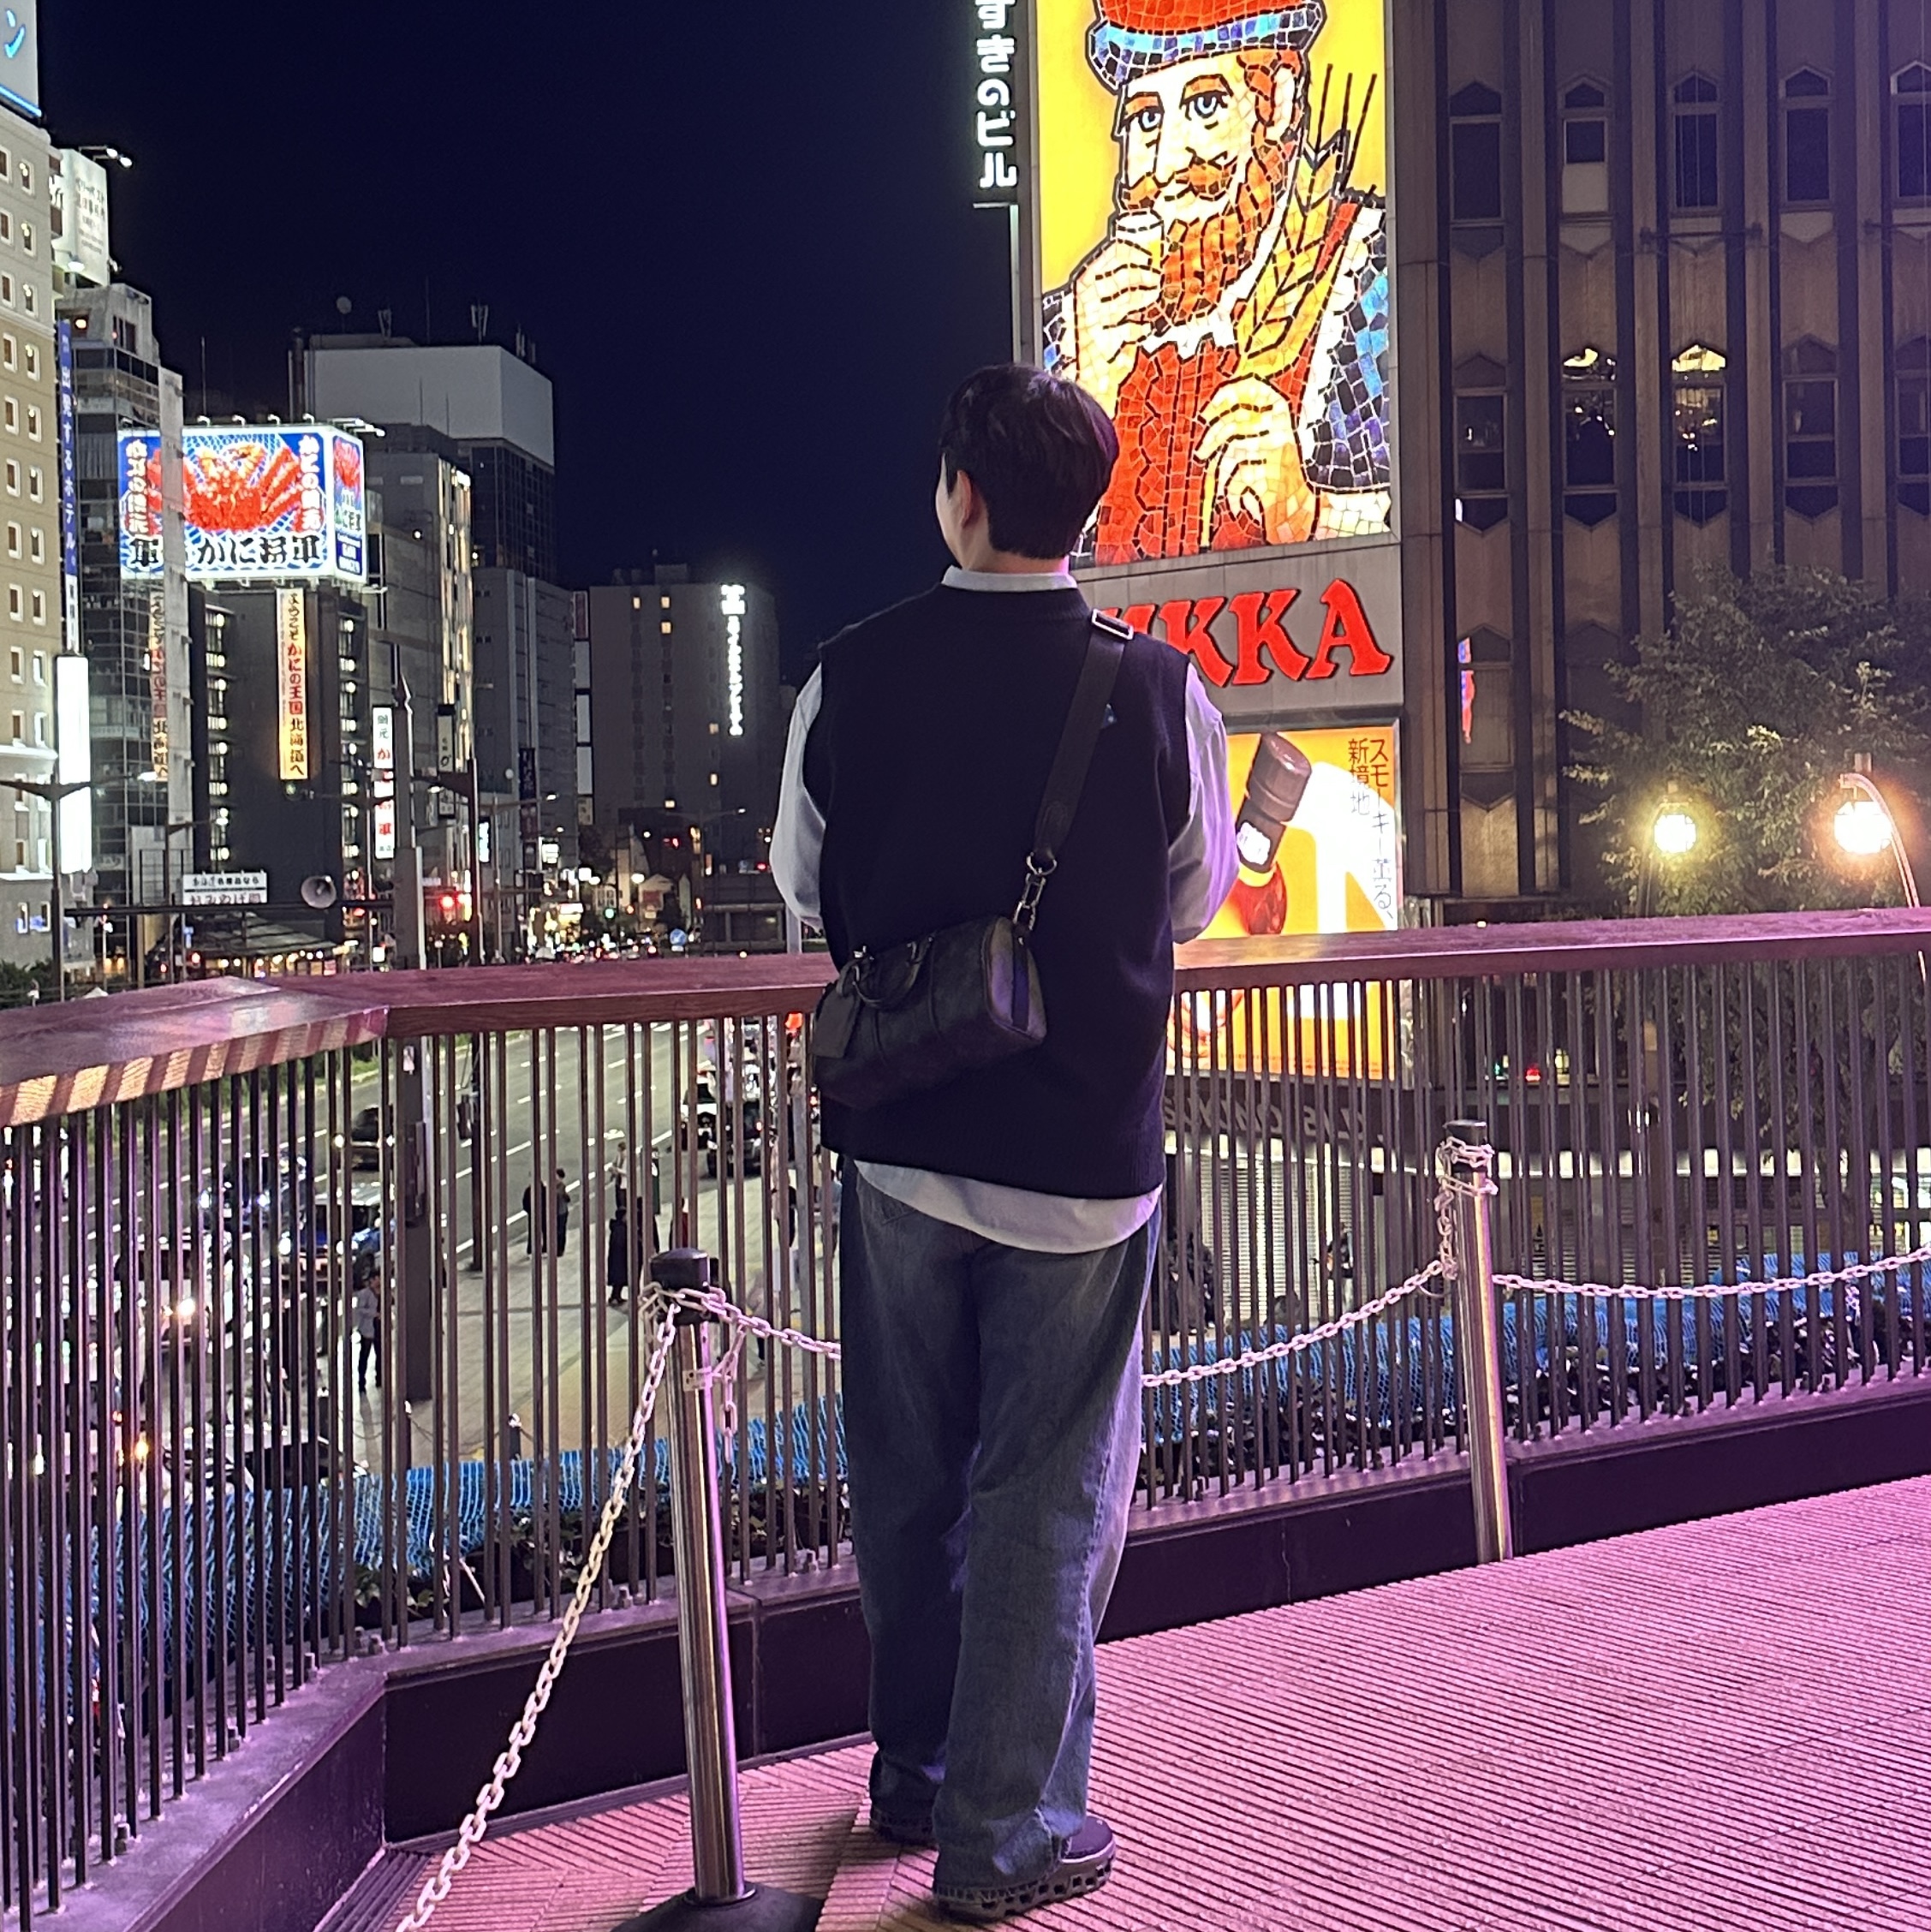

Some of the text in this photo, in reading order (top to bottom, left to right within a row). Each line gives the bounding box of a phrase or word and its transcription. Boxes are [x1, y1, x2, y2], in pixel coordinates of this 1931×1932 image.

[975, 0, 1017, 188] すきのビル
[1102, 579, 1392, 688] KKA
